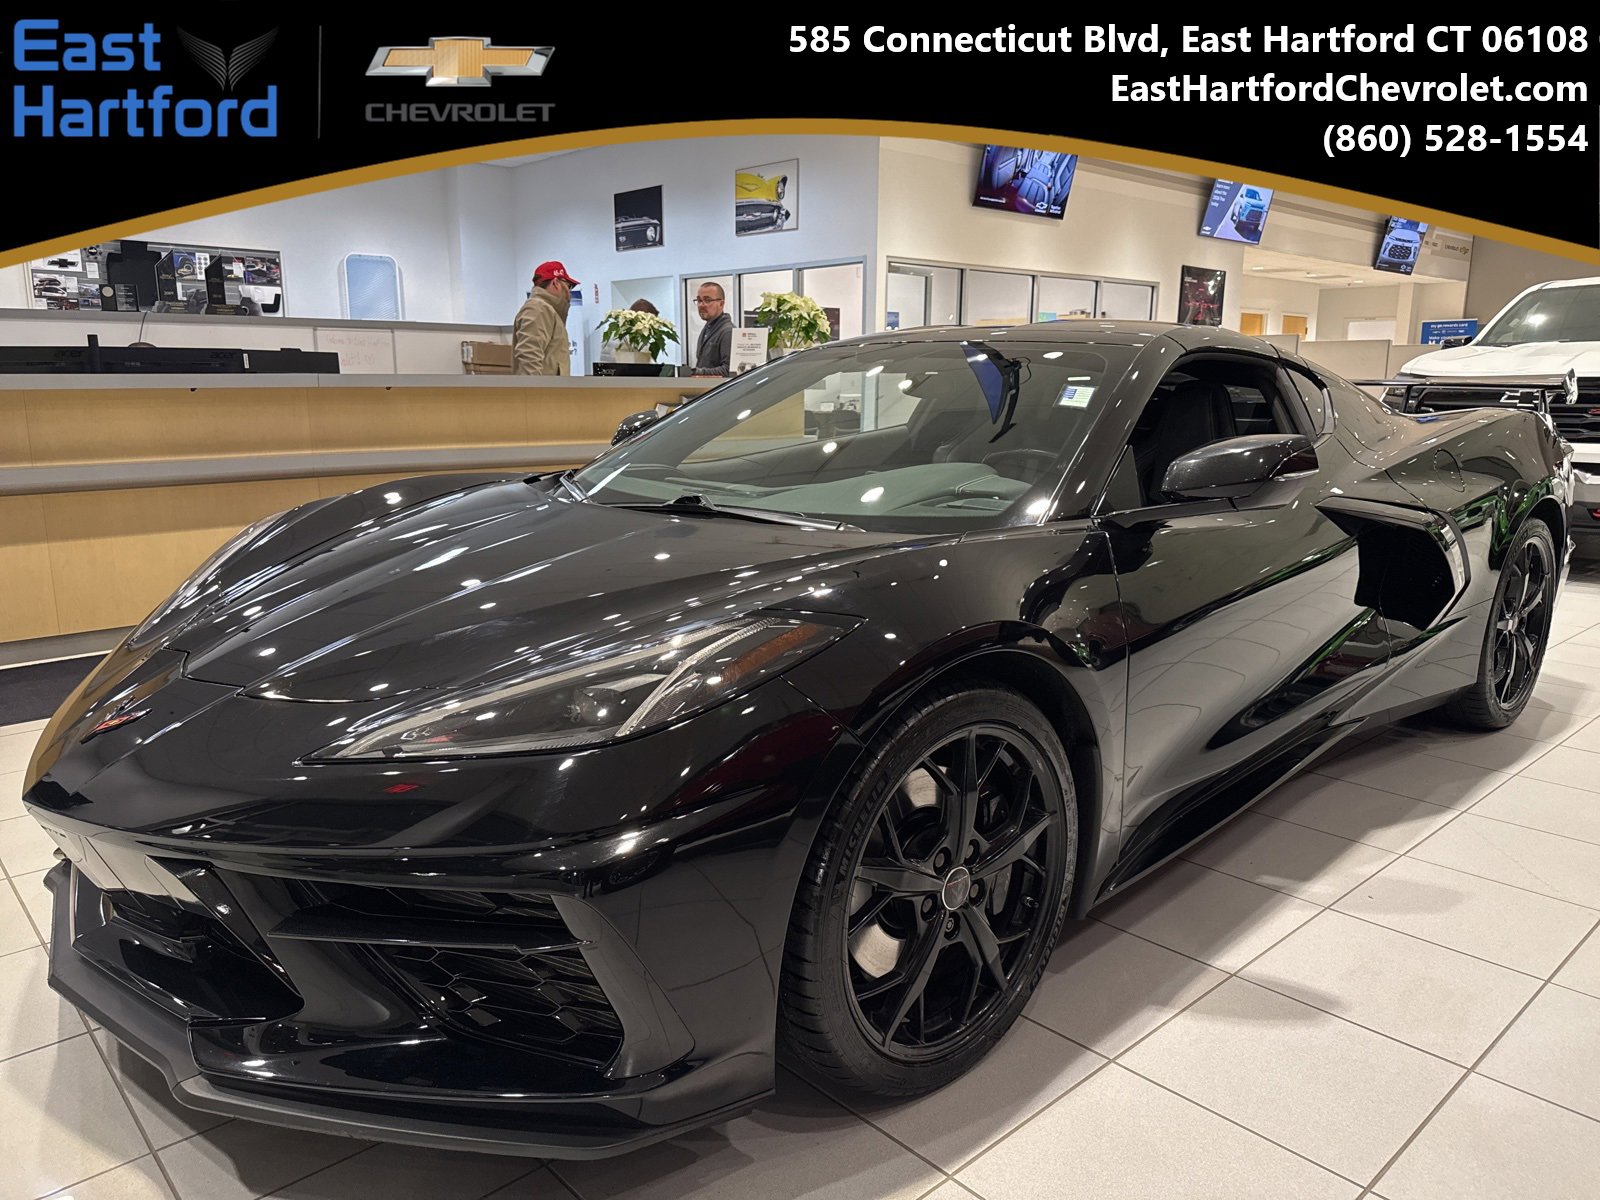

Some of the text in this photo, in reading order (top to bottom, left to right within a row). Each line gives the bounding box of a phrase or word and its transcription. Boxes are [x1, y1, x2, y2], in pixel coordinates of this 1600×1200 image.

[54, 350, 83, 358] acer
[210, 351, 235, 359] acer
[838, 779, 888, 878] MICHELIN
[1030, 904, 1067, 990] MICHELIN
